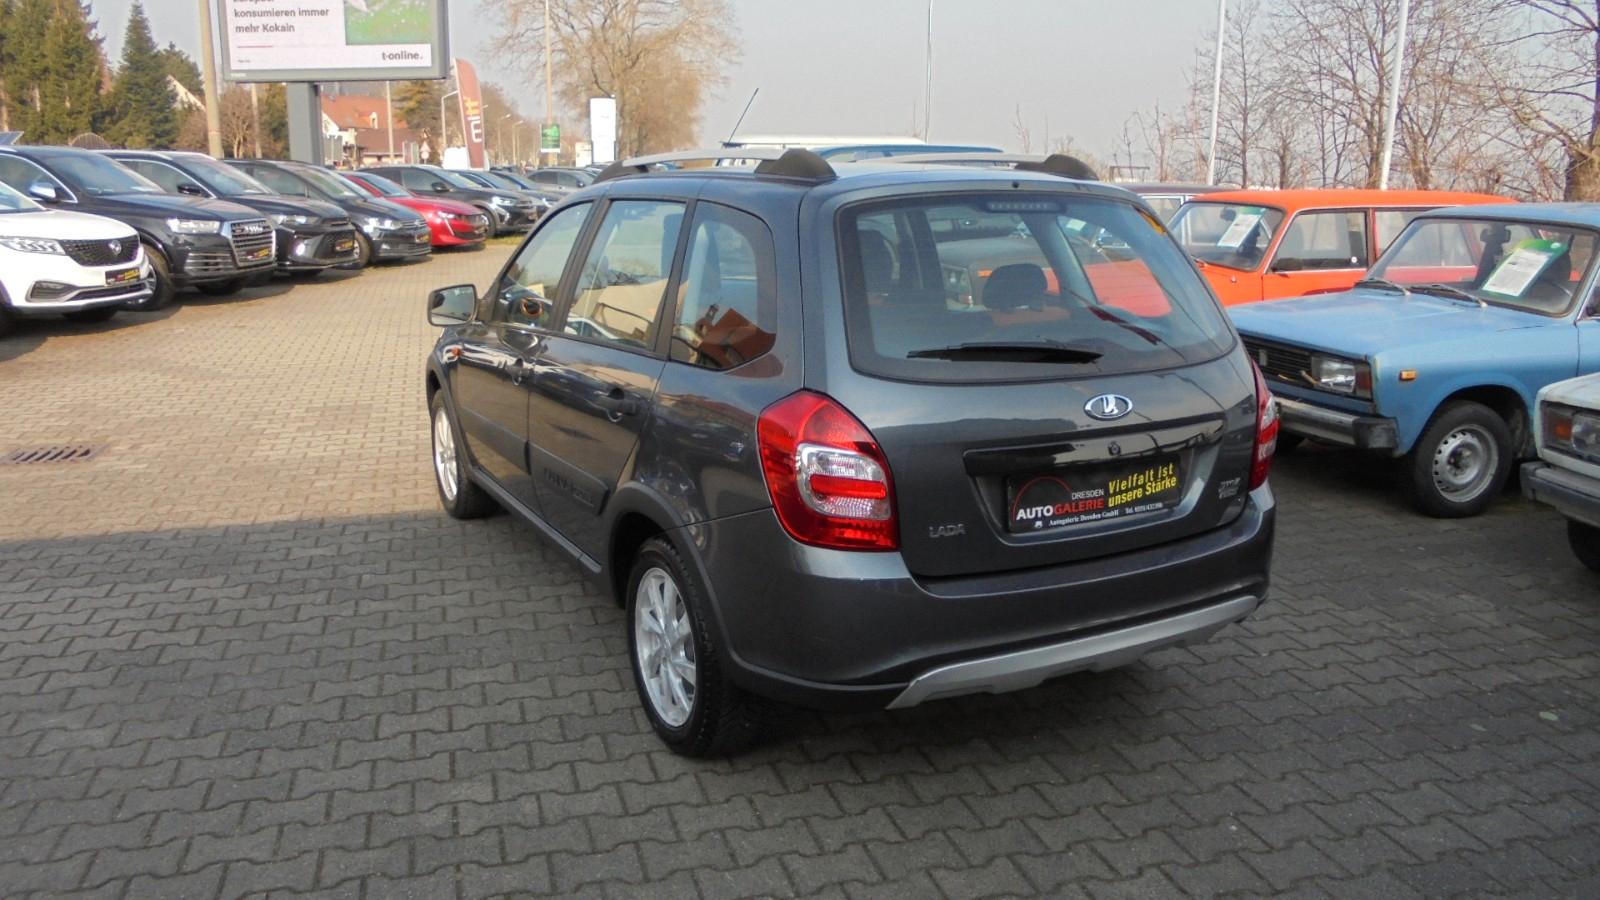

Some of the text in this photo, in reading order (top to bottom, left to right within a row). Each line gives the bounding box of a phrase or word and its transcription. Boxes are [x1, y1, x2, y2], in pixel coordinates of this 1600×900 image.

[234, 8, 329, 18] konsumieren immer
[235, 23, 295, 33] mehr Kokain
[1108, 469, 1154, 495] Vielfalt
[1071, 488, 1105, 500] DRESDEN
[1108, 487, 1143, 507] unsere
[929, 523, 967, 539] LADA
